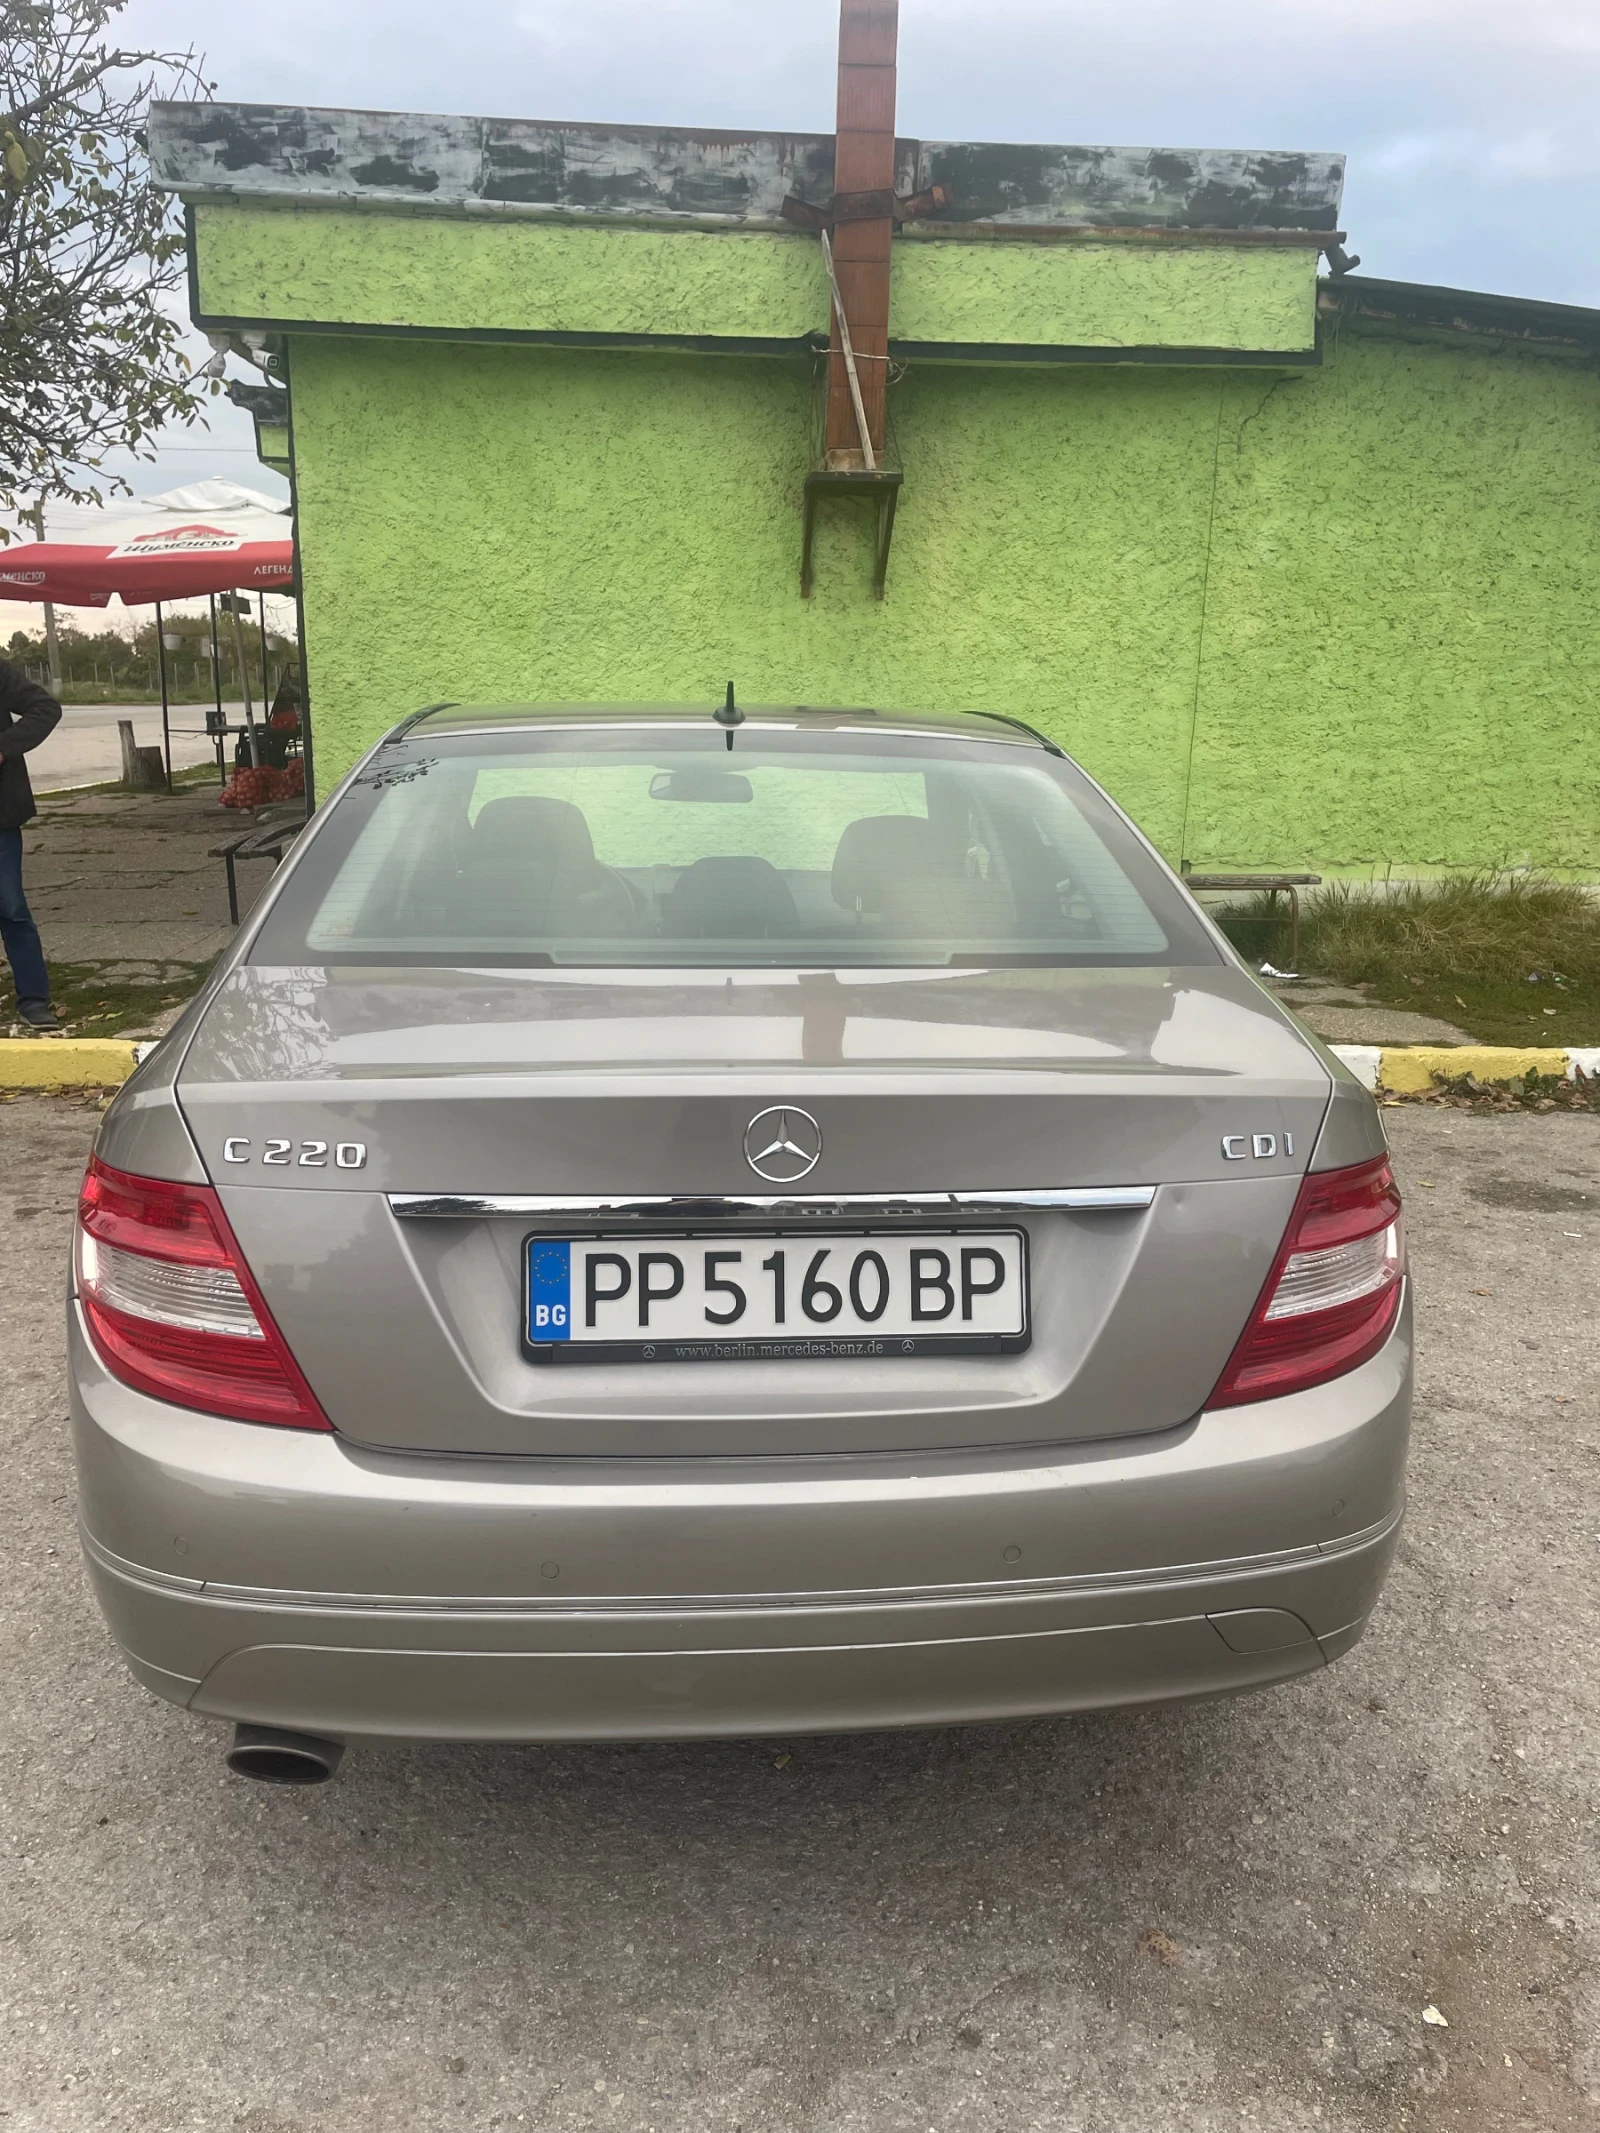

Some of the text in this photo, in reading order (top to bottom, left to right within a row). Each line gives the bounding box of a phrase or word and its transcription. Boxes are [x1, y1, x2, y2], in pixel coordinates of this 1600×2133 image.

[124, 540, 234, 553] Шуменско
[0, 571, 46, 581] менско
[223, 1137, 368, 1169] C 220
[1221, 1132, 1294, 1160] CDI
[704, 1250, 890, 1325] 5160
[535, 1304, 567, 1327] BG
[675, 1341, 884, 1357] www.berlin.mercedes-benz.de
